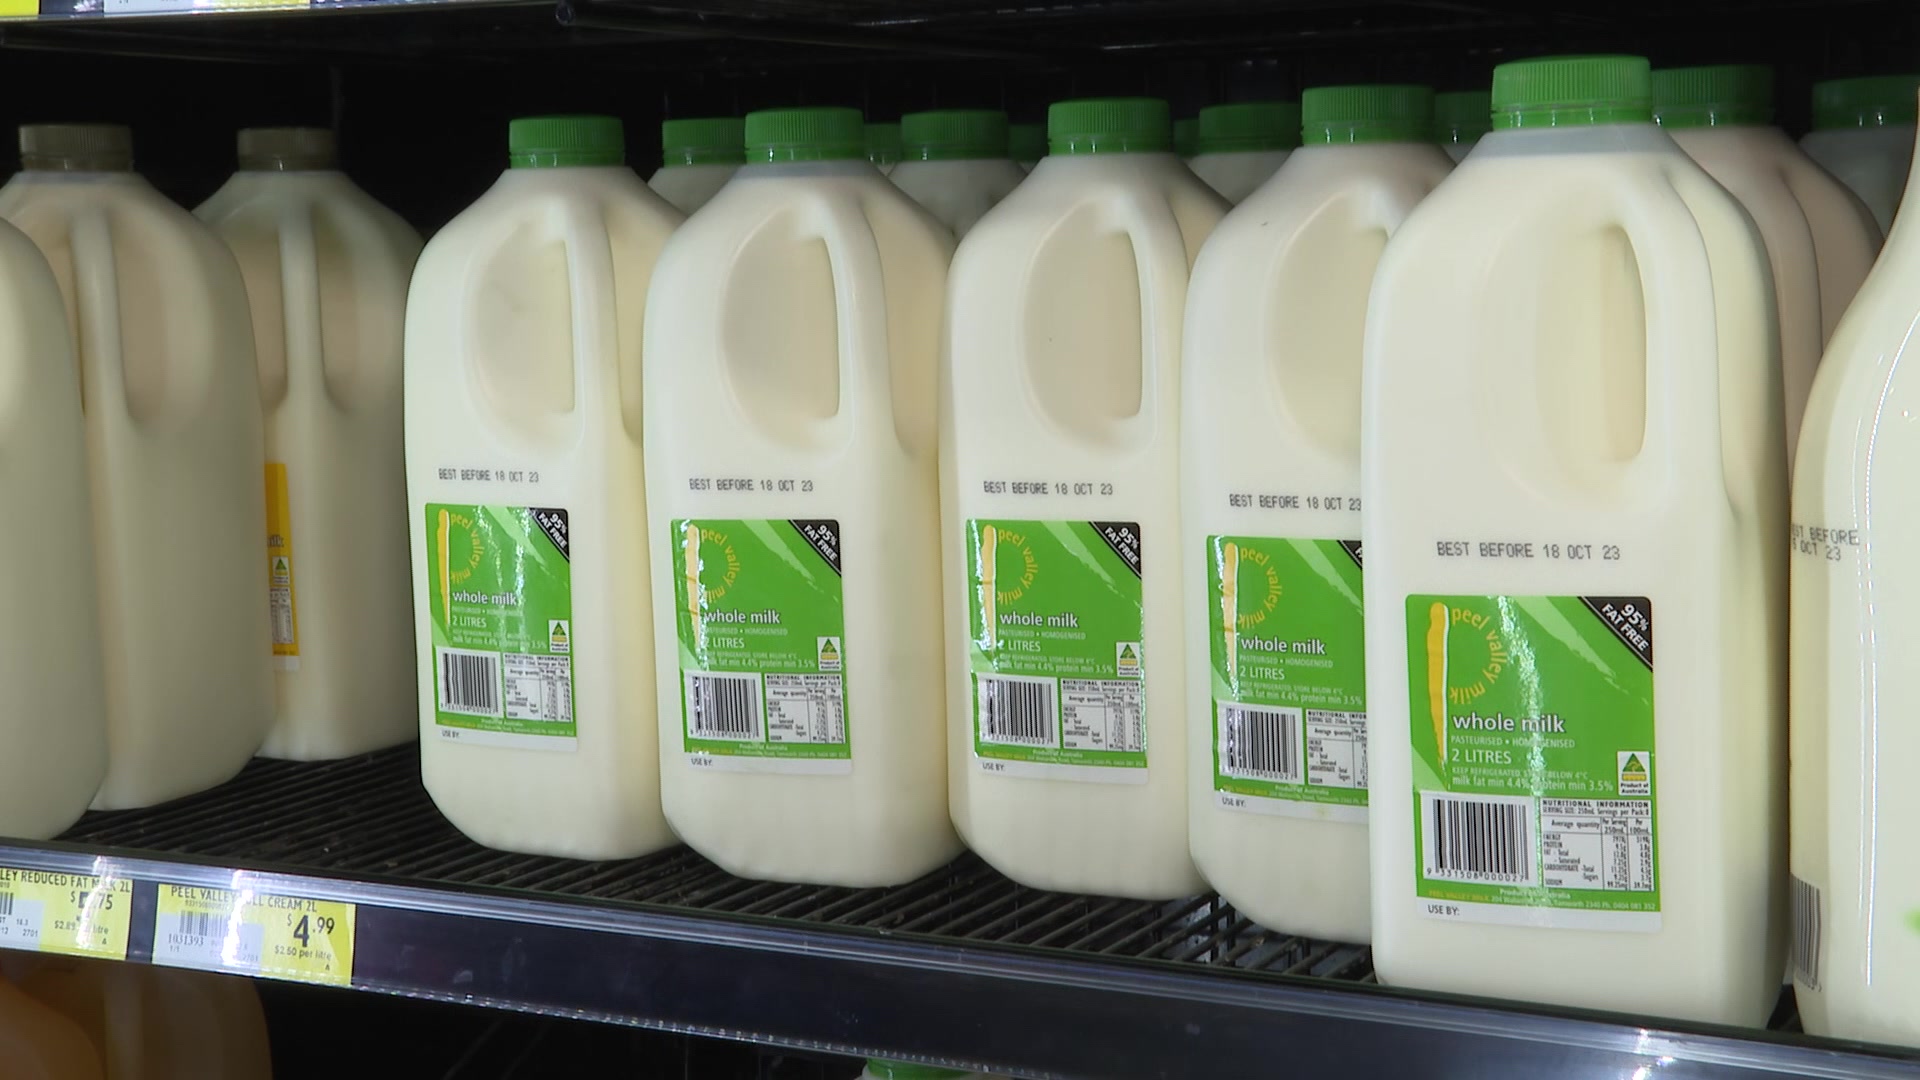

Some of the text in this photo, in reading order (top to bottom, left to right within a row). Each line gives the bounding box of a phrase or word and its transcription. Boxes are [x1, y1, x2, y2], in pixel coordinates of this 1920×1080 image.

[438, 468, 539, 483] BEST BEFORE 18 OCT 23
[689, 478, 813, 492] BEST BEFORE 18 OCT 23
[983, 480, 1113, 495] BEST BEFORE 18 OCT 23
[1229, 493, 1361, 511] BEST BEFORE 18 OCT 23
[538, 512, 567, 548] FAT FREE
[550, 513, 567, 534] 95%
[803, 524, 838, 562] FAT FREE
[817, 525, 837, 546] 95%
[1117, 527, 1139, 549] 95%
[1809, 527, 1860, 546] BEFORE
[450, 513, 485, 584] peel valley milk
[1104, 526, 1139, 565] FAT FREE
[1436, 541, 1620, 560] BEST BEFORE 18 OCT 23
[1800, 539, 1817, 556] OCT
[1825, 545, 1841, 562] 23
[701, 528, 727, 546] peel
[722, 545, 740, 587] valley
[997, 529, 1038, 606] peel valley milk
[1238, 547, 1283, 630] peel valley milk
[452, 589, 518, 606] whole milk
[452, 616, 487, 628] 2 LITRES
[704, 608, 780, 624] whole milk
[999, 610, 1079, 628] whole milk
[1621, 603, 1649, 631] 95%
[1041, 631, 1086, 640] HOMOGENISED
[1601, 603, 1650, 652] FAT FREE
[713, 637, 745, 648] LITRES
[1007, 640, 1041, 652] LITRES
[1241, 635, 1326, 655] whole milk
[1285, 658, 1333, 668] HOMOGENISED
[1449, 607, 1508, 705] peel valley milk
[1055, 663, 1078, 674] protein
[1240, 666, 1285, 680] 2 LITRES
[1300, 693, 1325, 703] protein
[1452, 711, 1566, 733] whole milk
[1451, 735, 1575, 749] PASTEURISED HOMGENISED
[691, 757, 703, 766] USE
[1452, 748, 1512, 764] 2 LITRES
[983, 762, 994, 770] USE
[1452, 767, 1468, 775] KEEP
[1452, 775, 1613, 793] milk fat min 4.4% min 3.5%
[1221, 797, 1234, 807] USE
[1597, 809, 1618, 817] Servings
[1551, 820, 1600, 830] Average quantity
[20, 871, 67, 886] REDUCED
[70, 875, 88, 888] FAT
[91, 879, 116, 892] MK
[119, 880, 130, 893] 2L
[171, 885, 318, 913] PEEL VALLEY ULL CREAM 2L
[1428, 904, 1460, 916] USE BY:
[168, 933, 204, 947] 1031393
[299, 948, 313, 960] per
[315, 949, 332, 961] litre
